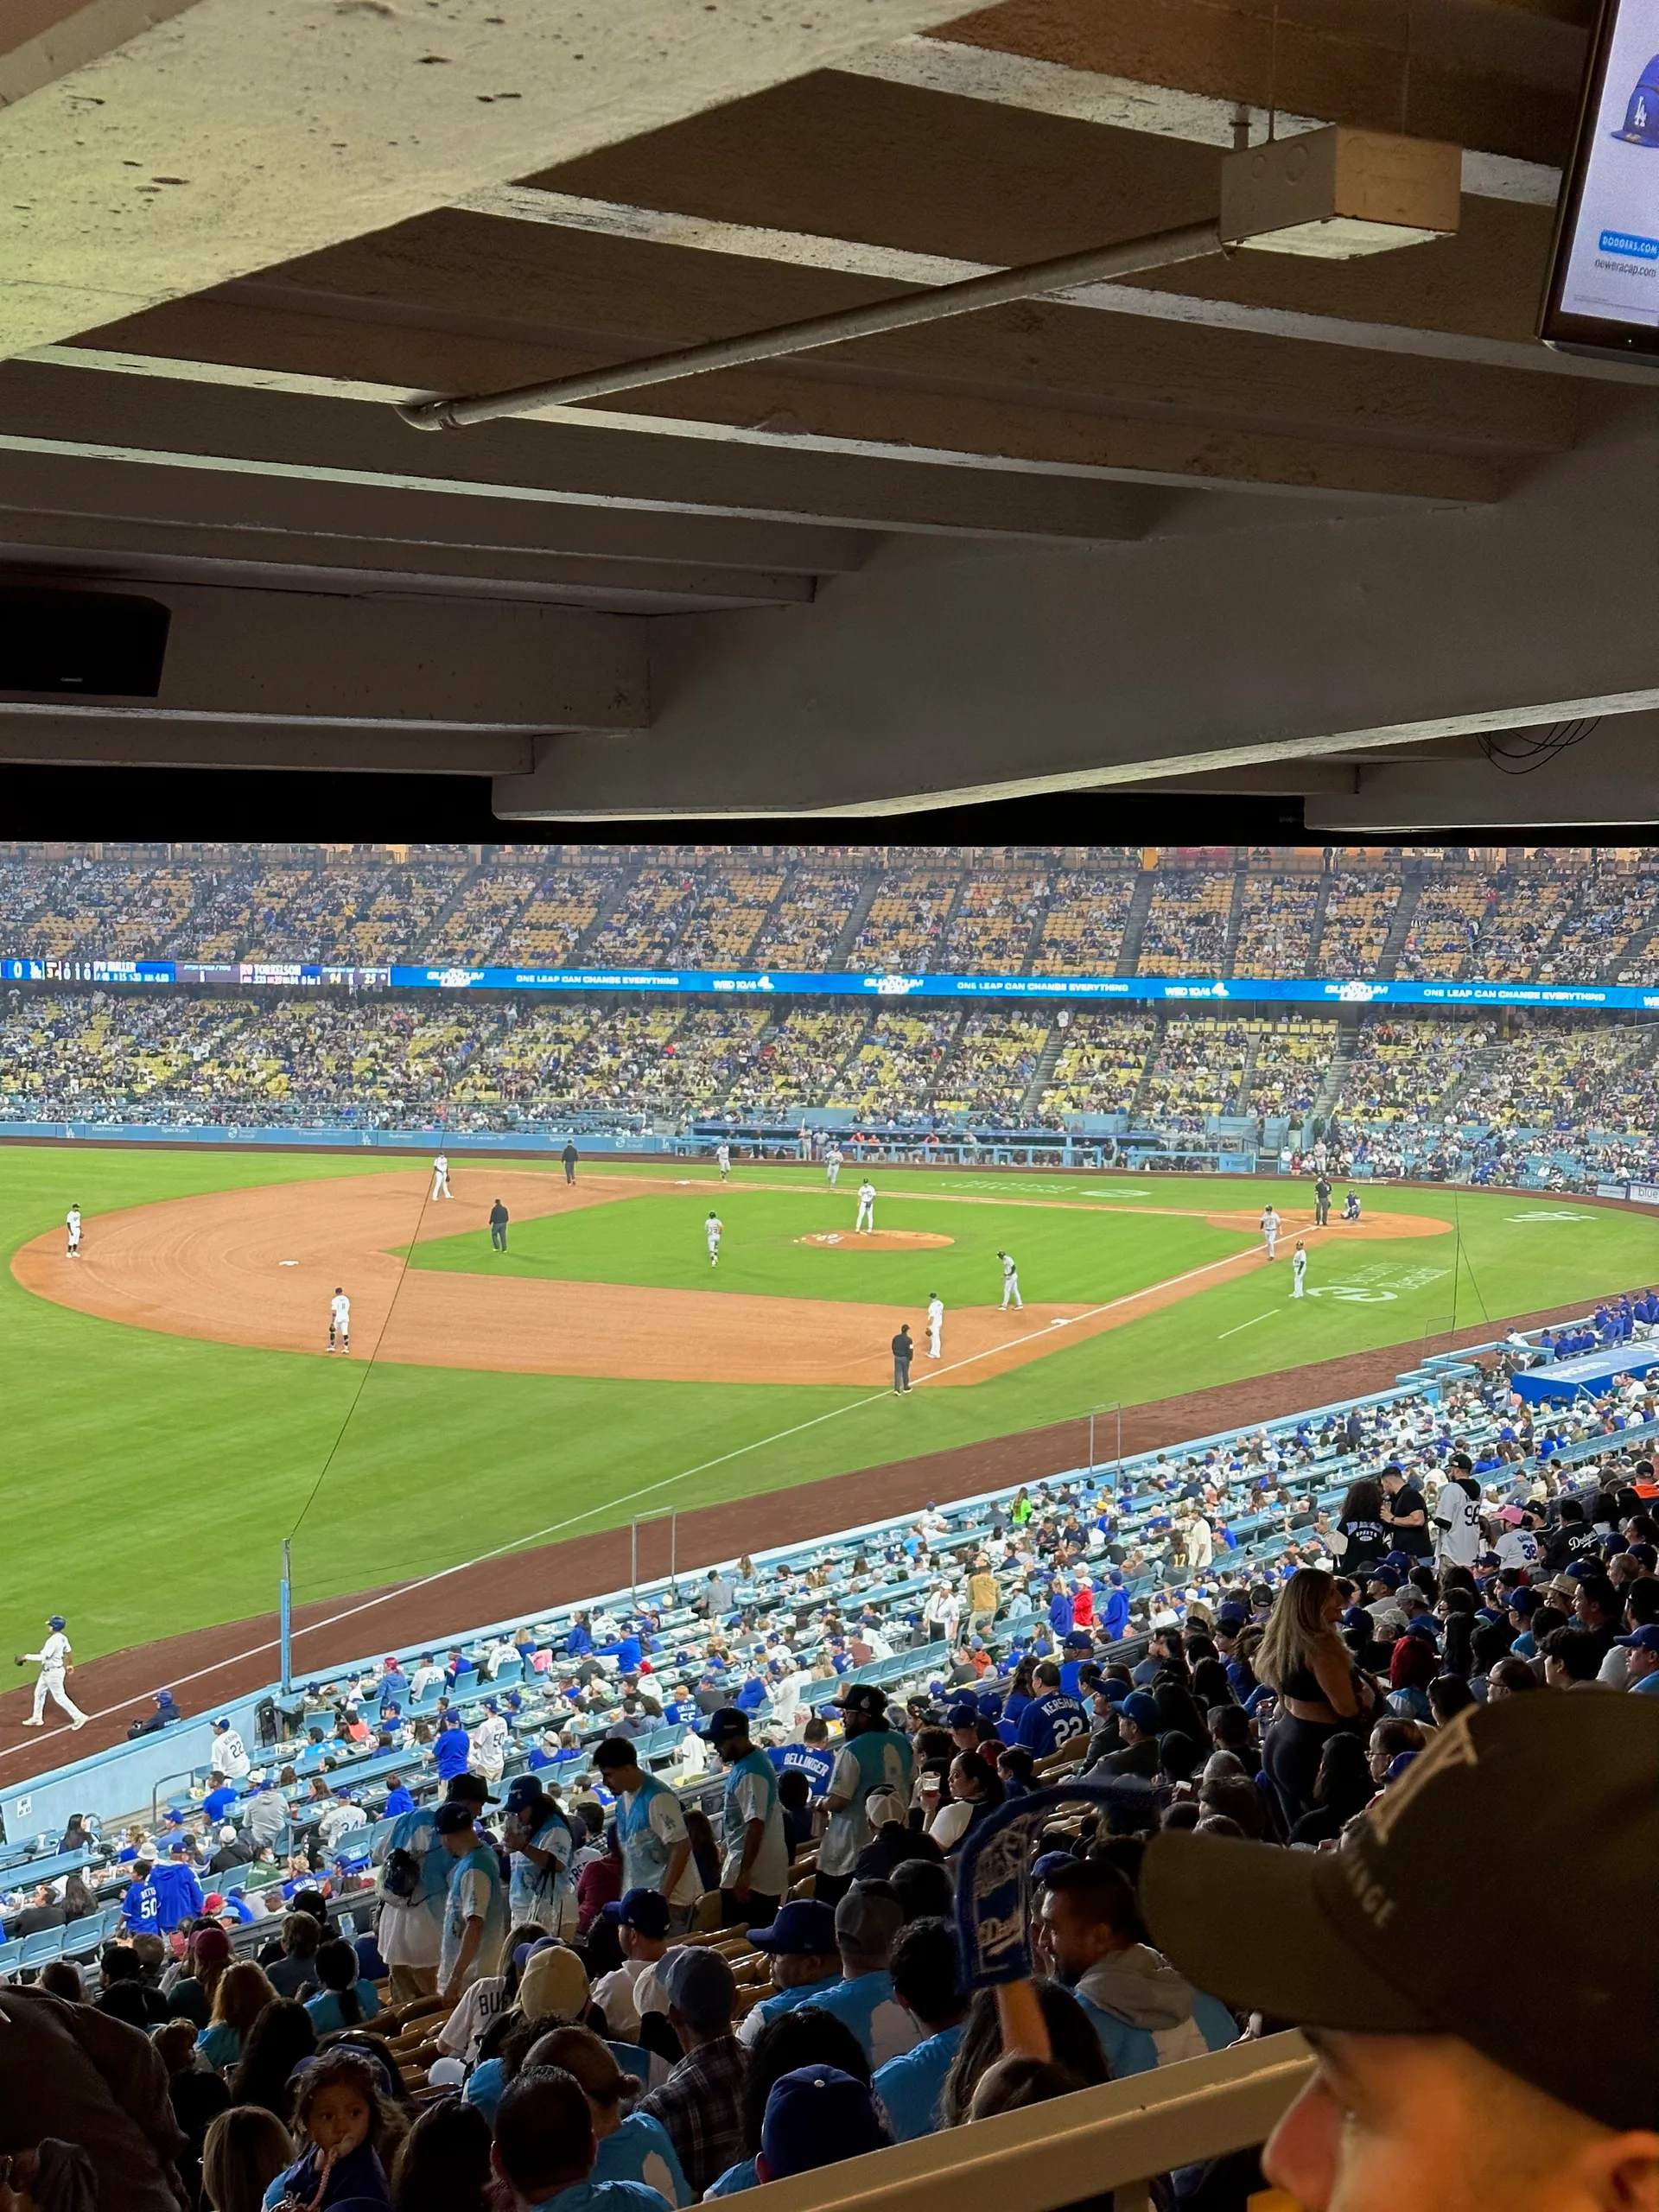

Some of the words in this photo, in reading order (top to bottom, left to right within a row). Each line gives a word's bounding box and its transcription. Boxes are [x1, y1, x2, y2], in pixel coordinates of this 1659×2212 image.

[1594, 258, 1657, 277] neweracap.com
[621, 976, 678, 985] EVERYTHING
[957, 982, 976, 990] ONE
[979, 982, 1003, 990] LEAP
[1004, 982, 1026, 991] CAN
[1027, 982, 1067, 991] CHANGE
[1069, 983, 1128, 992] EVERYTHING
[1423, 988, 1445, 997] ONE
[1447, 989, 1473, 998] LEAP
[1474, 989, 1497, 999] CAN
[1498, 990, 1541, 1000] CHANGE
[1542, 991, 1606, 1001] EVERYTHING
[1568, 1530, 1598, 1552] Dodgers
[1173, 1553, 1186, 1568] 17
[1052, 1716, 1084, 1747] 22
[783, 1752, 830, 1777] BELLINGER
[141, 1897, 158, 1920] 50
